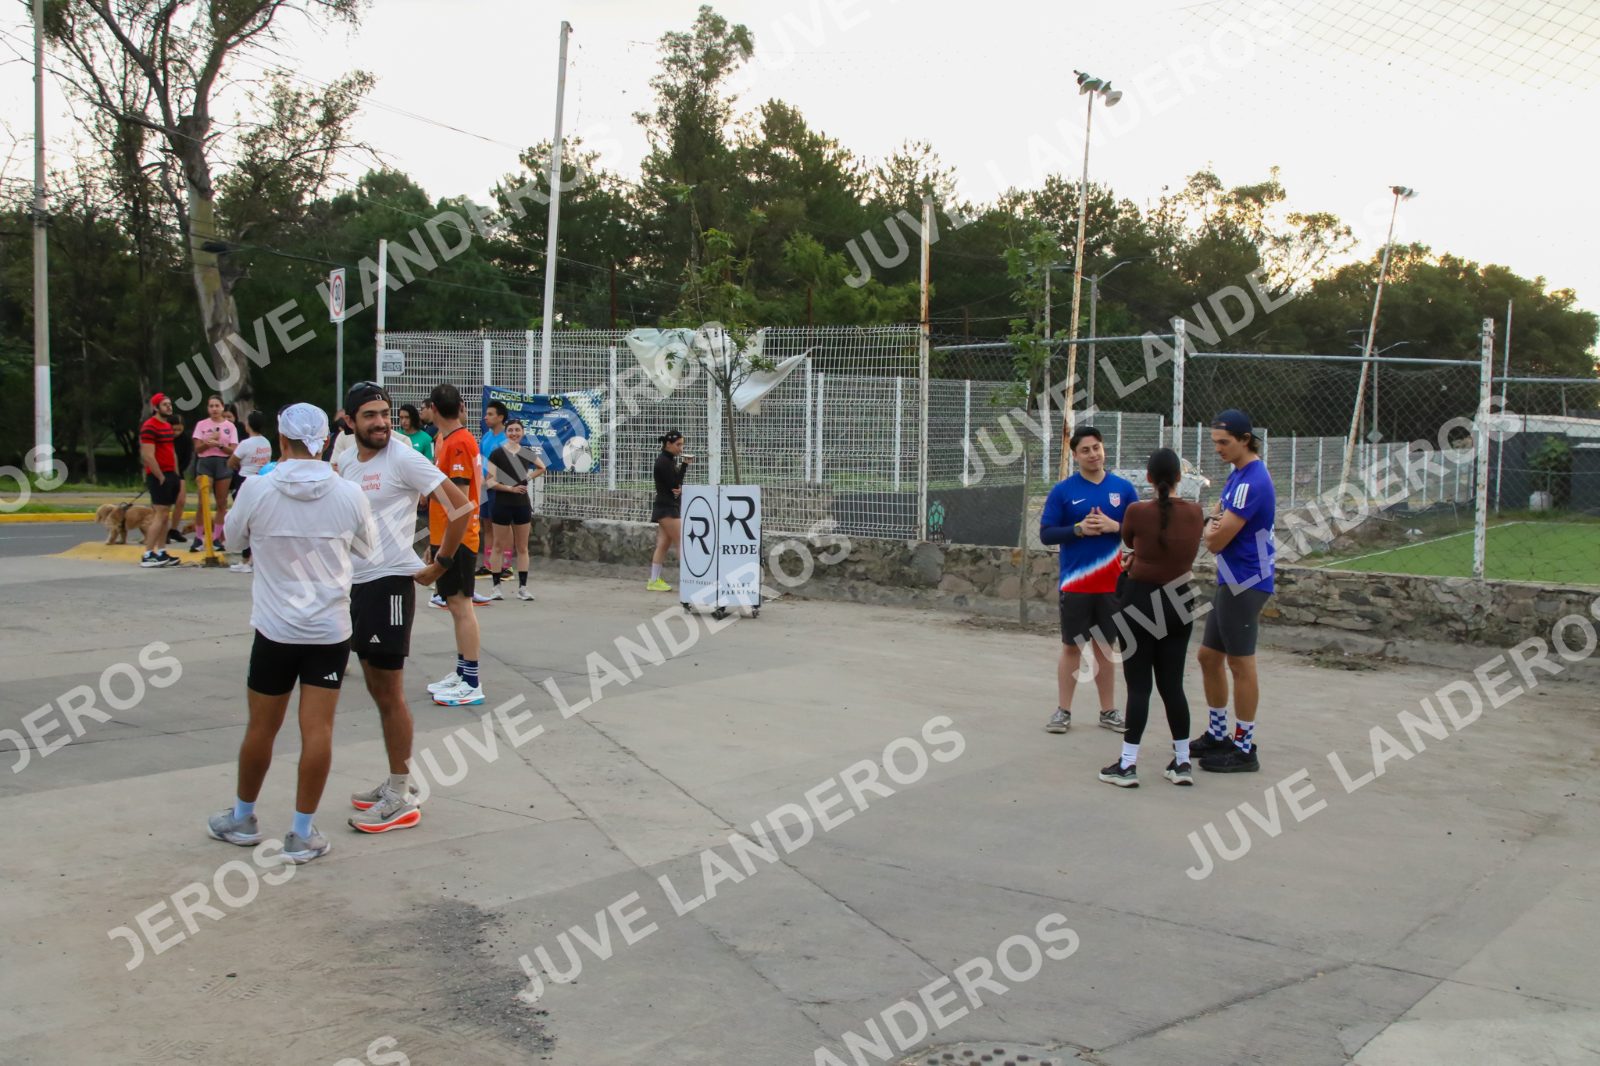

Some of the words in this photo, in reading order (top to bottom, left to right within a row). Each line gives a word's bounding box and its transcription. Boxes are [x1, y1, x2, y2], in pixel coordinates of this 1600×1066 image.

[490, 390, 522, 402] CURSOS
[522, 394, 534, 403] DE
[530, 420, 550, 428] JULIO
[722, 544, 757, 555] RYDE
